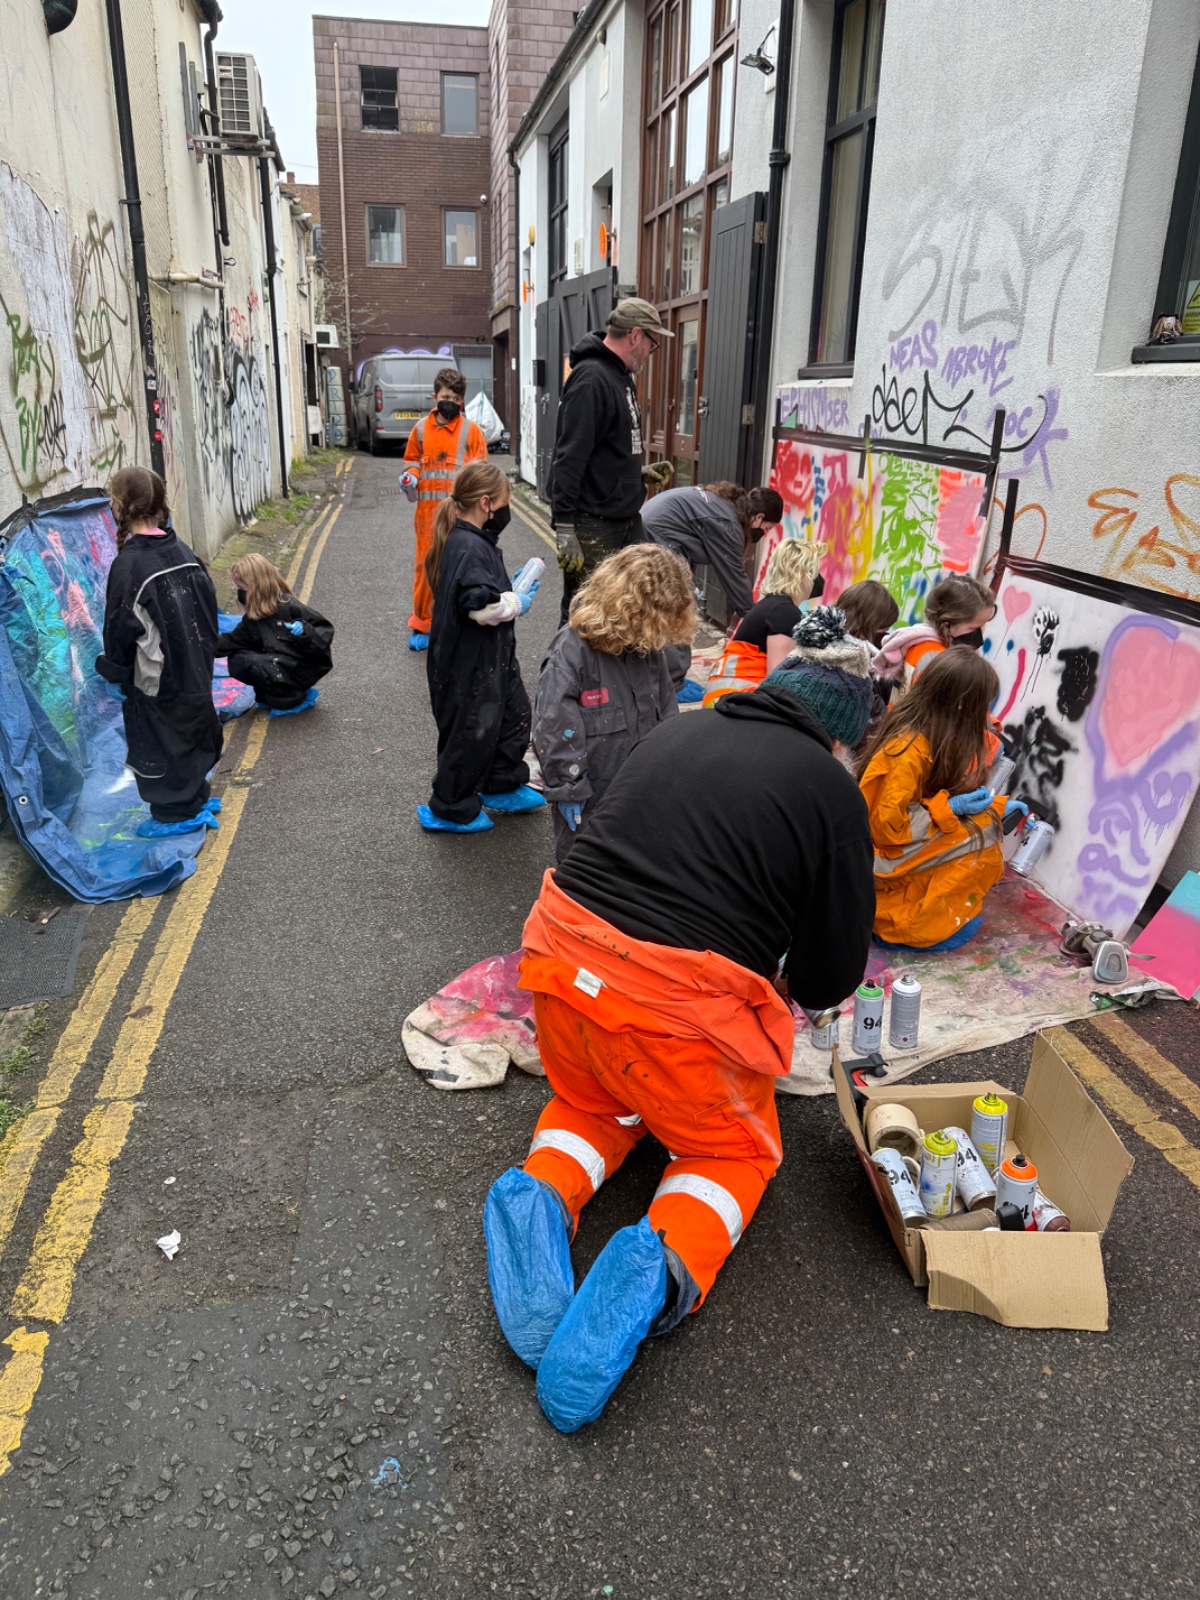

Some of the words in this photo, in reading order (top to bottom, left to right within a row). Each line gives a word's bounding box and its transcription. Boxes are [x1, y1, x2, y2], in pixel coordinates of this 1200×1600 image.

[863, 1015, 883, 1030] 94
[957, 1148, 977, 1168] 94
[889, 1168, 912, 1186] 94
